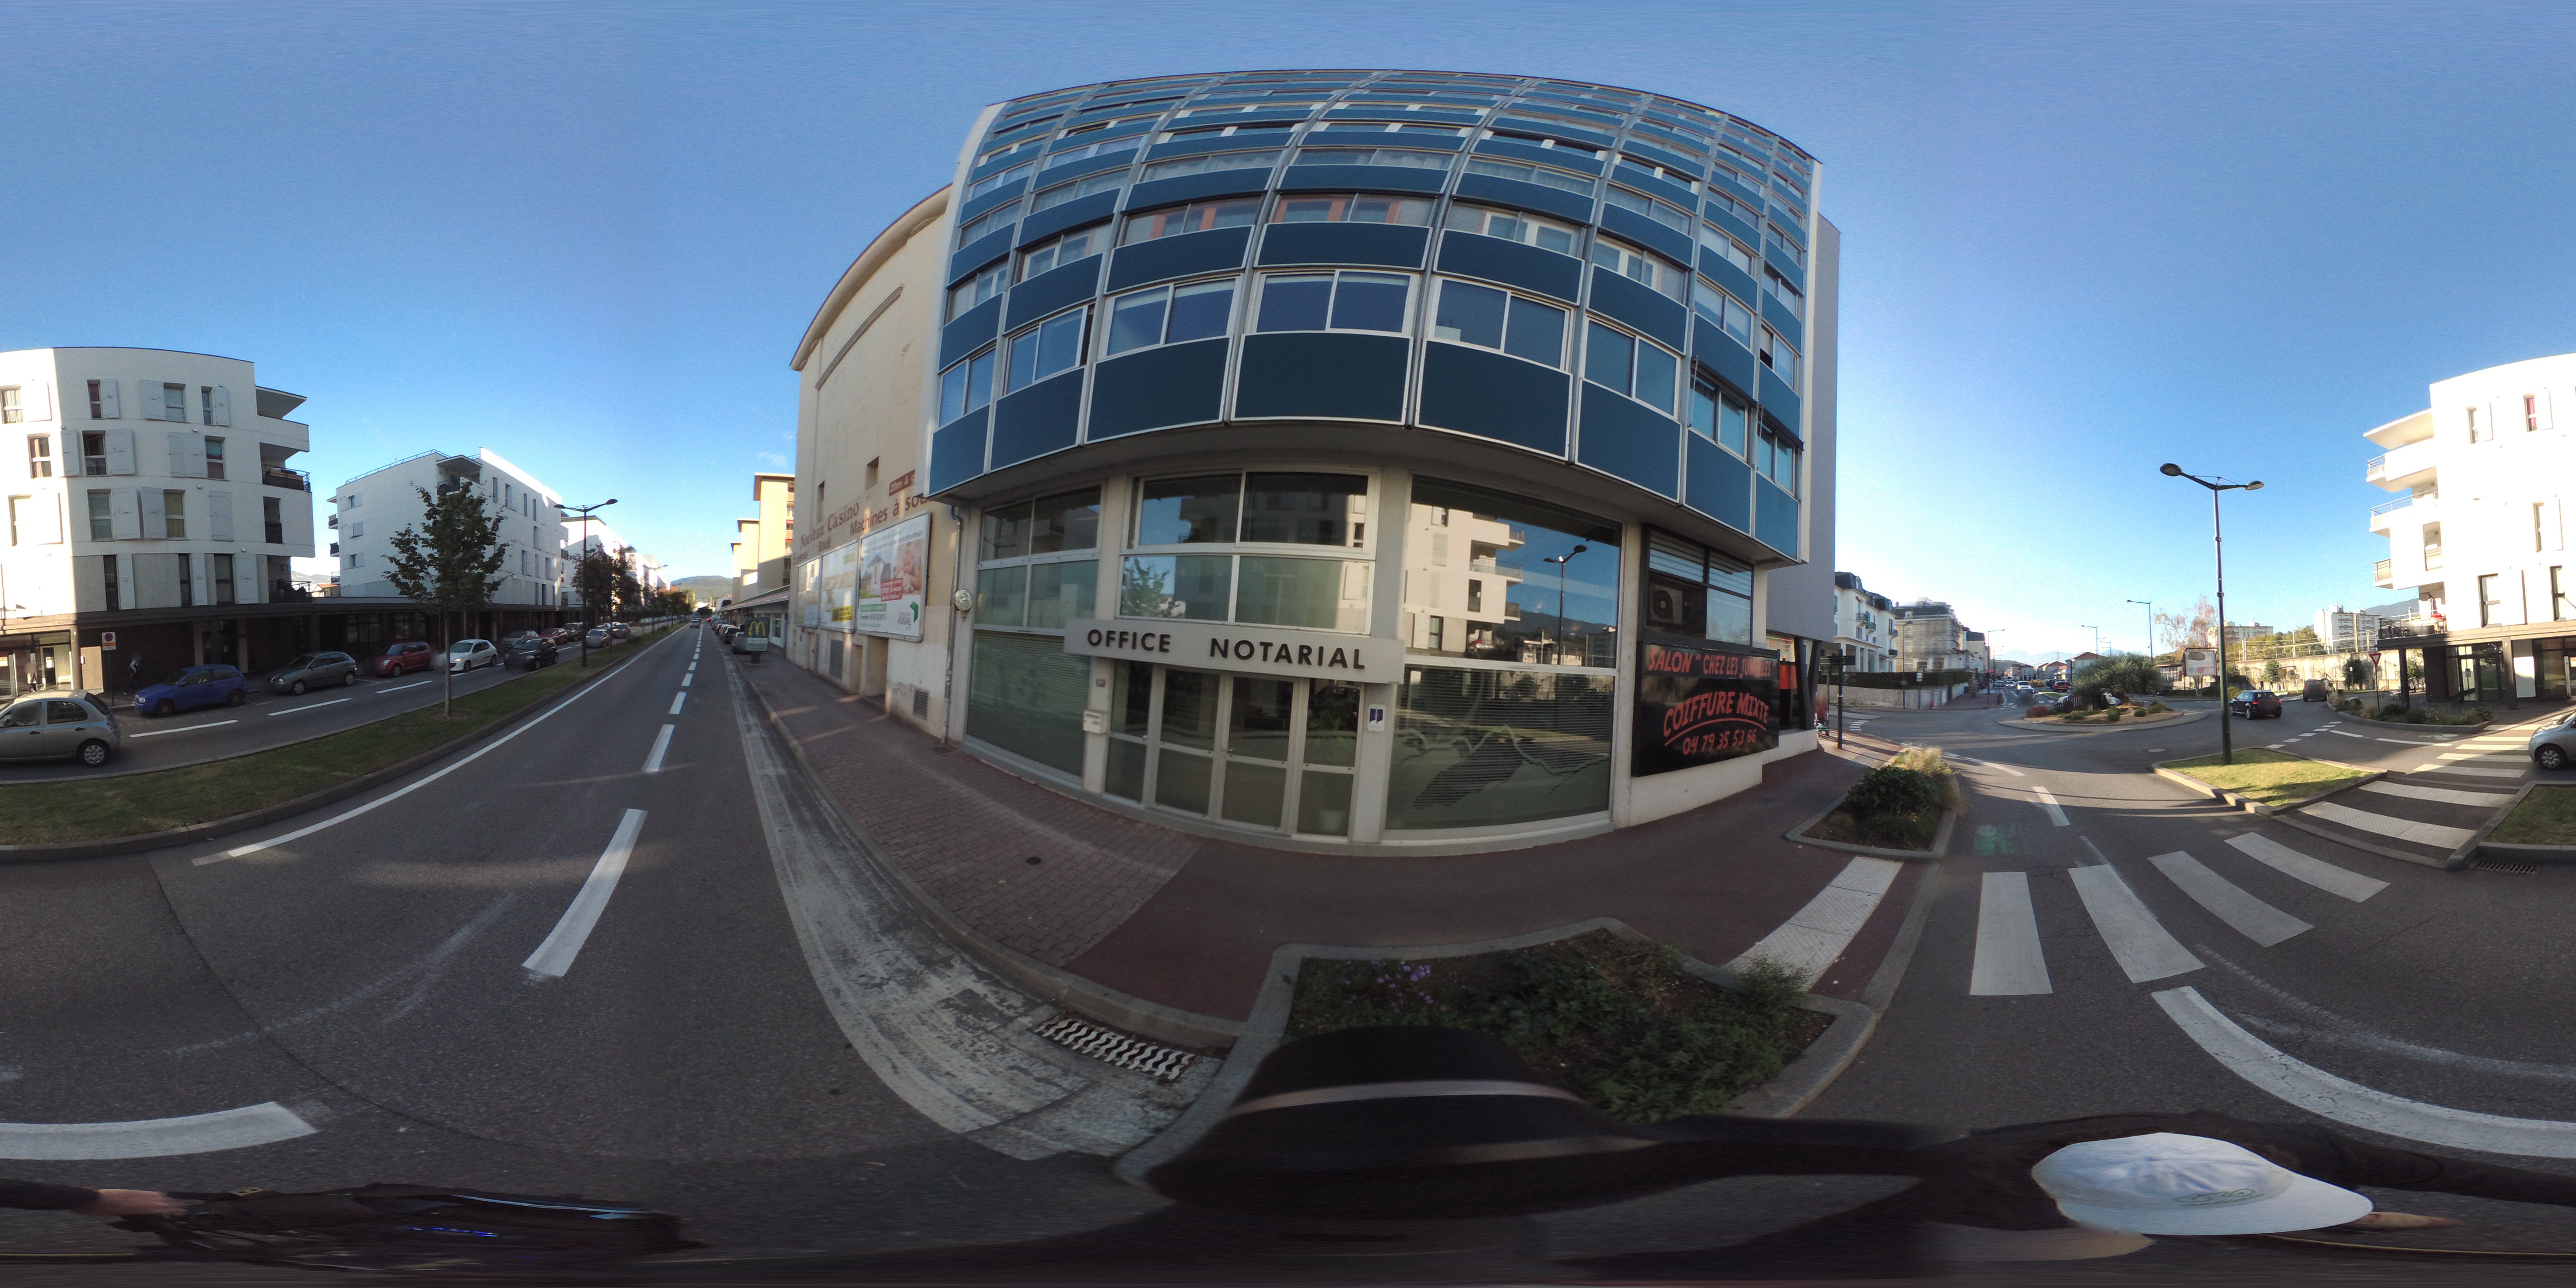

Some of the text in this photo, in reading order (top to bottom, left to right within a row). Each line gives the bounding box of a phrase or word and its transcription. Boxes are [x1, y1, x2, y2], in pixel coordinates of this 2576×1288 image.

[800, 502, 859, 550] Nouveau Casino
[850, 507, 887, 536] Machines
[893, 498, 899, 516] à
[1087, 628, 1365, 670] OFFICE NOTARIAL
[1648, 650, 1693, 673] SALON
[1703, 655, 1725, 675] CHEZ
[1726, 657, 1738, 675] LES
[1663, 691, 1769, 737] COIFFURE MIXTE
[1683, 728, 1758, 755] 04 79 35 53 66
